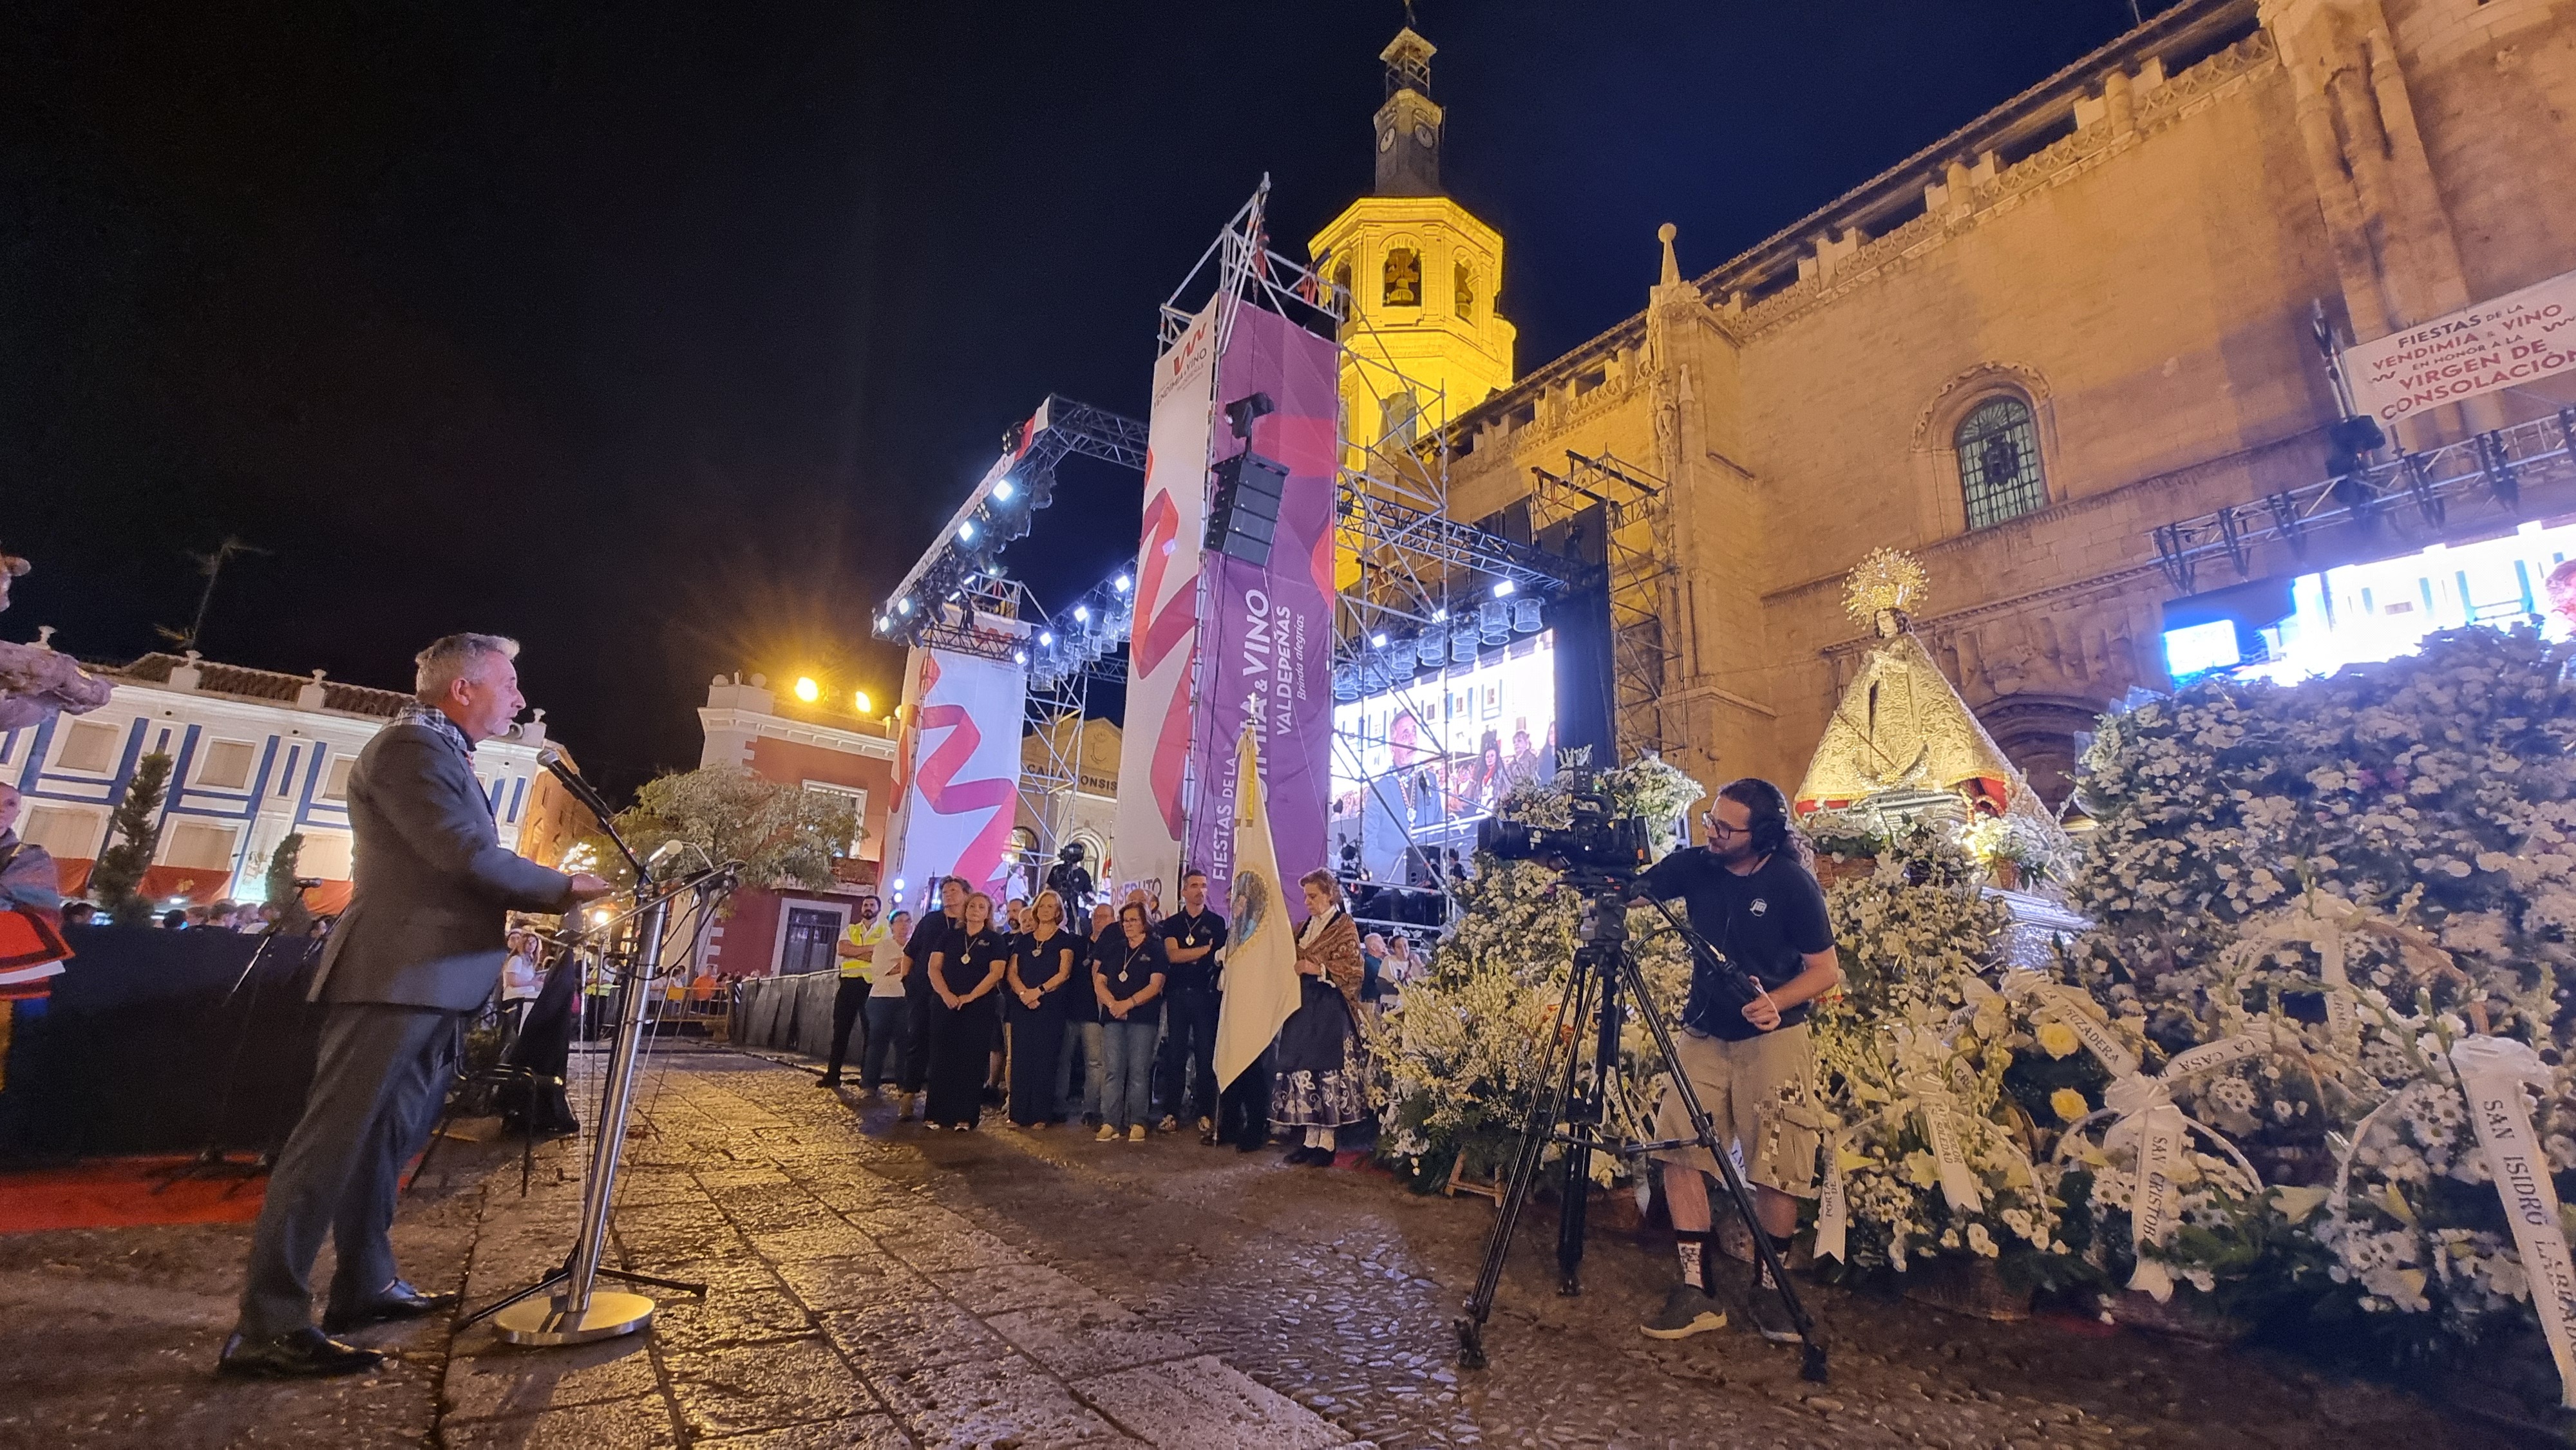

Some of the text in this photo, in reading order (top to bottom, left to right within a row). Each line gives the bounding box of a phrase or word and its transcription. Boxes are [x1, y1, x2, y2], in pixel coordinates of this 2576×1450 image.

[2372, 333, 2479, 370] VENDIMIA
[2502, 304, 2562, 330] VINO
[2398, 305, 2523, 348] FIESTAS DE LA
[1186, 348, 1207, 370] VINO
[2399, 339, 2547, 390] VIRGEN DE
[2412, 361, 2429, 370] EN
[2434, 344, 2486, 364] HONOR
[2506, 335, 2523, 344] LA
[1243, 589, 1270, 677] VINO
[1255, 679, 1268, 693] &
[1273, 606, 1293, 735] VALDEPEÑAS
[1295, 663, 1306, 701] Brinda
[1213, 757, 1236, 880] FIESTAS DE LA
[2179, 1051, 2224, 1071] CASA
[2233, 1039, 2255, 1053] LA
[1937, 1122, 1953, 1163] SOLEDAD
[2484, 1100, 2515, 1139] SAN
[2503, 1156, 2548, 1225] ISIDRO
[2143, 1136, 2168, 1239] SAN CRISTOB
